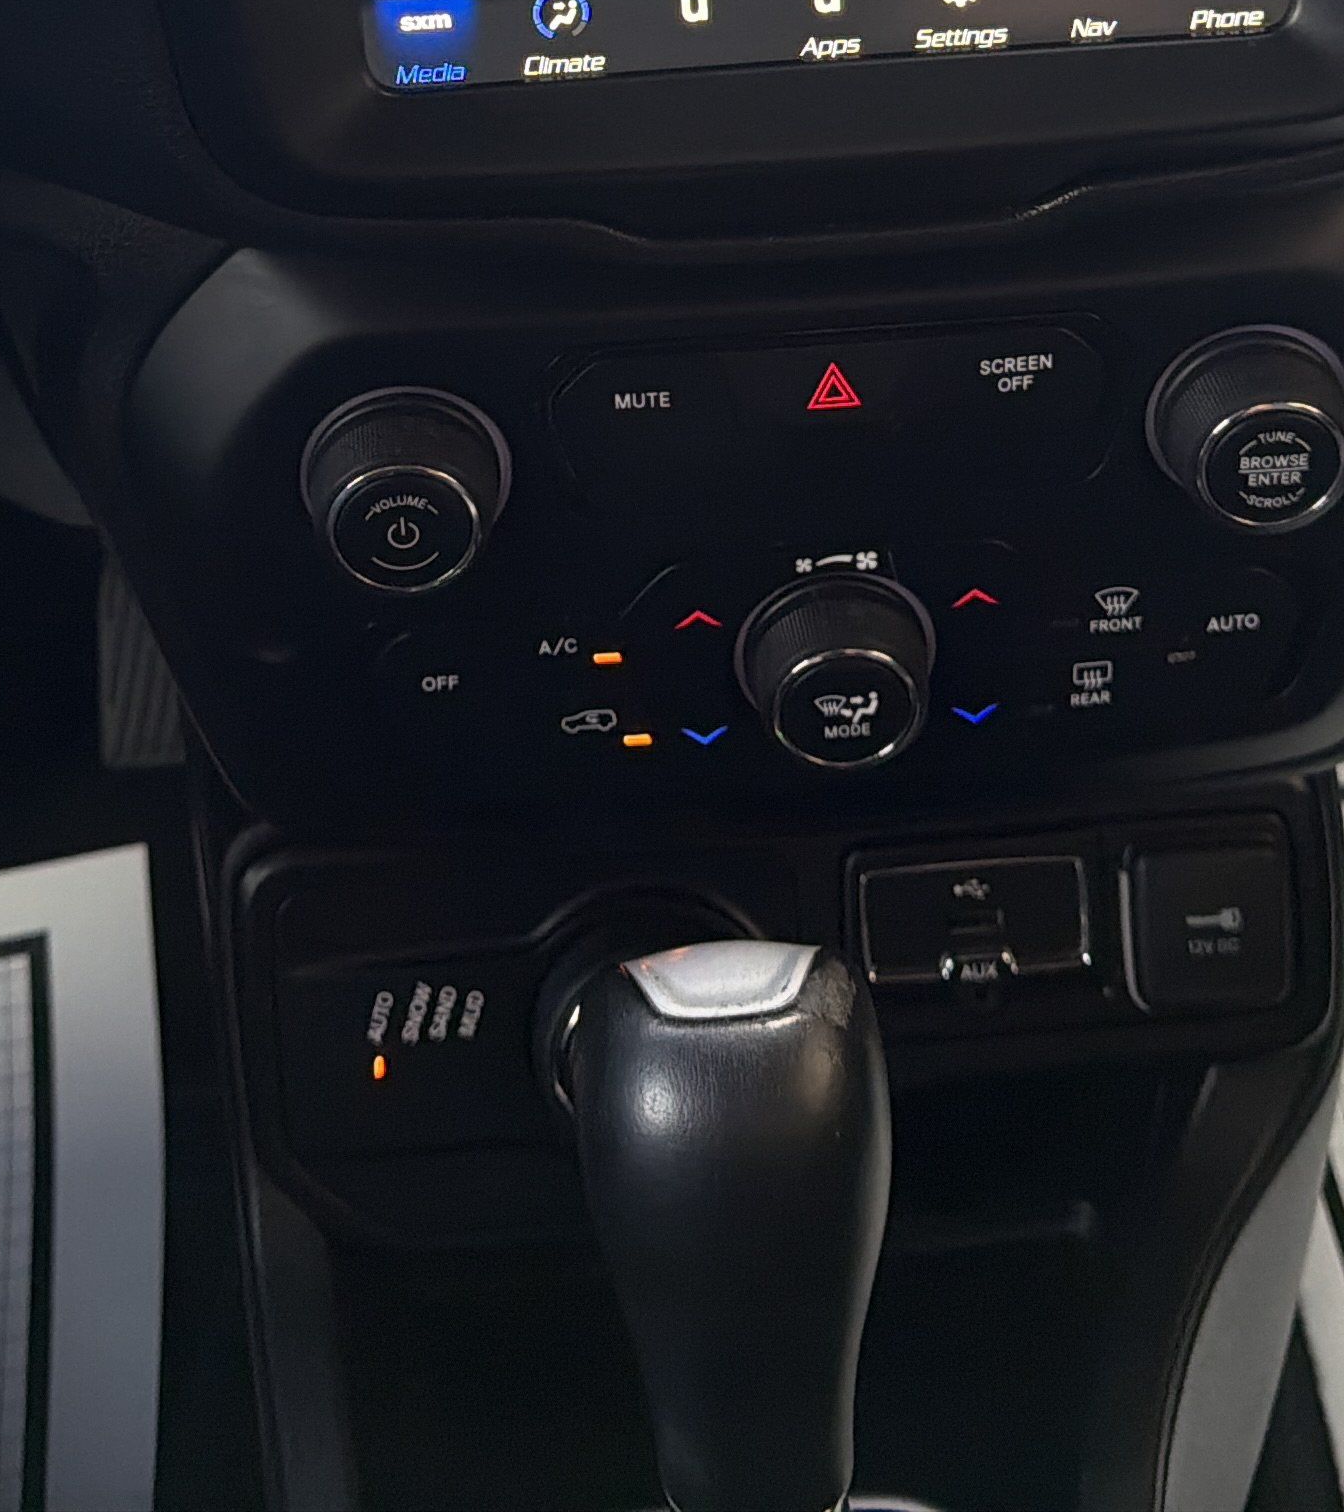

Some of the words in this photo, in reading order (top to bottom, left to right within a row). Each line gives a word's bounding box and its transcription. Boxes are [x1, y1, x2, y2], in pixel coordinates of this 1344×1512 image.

[1071, 17, 1117, 39] Nav
[1189, 8, 1265, 32] Phone
[915, 25, 1008, 50] Settings
[799, 36, 862, 59] Apps
[523, 52, 606, 77] Climate
[396, 63, 467, 87] Media
[979, 353, 1053, 375] SCREEN
[997, 374, 1034, 393] OFF
[614, 391, 672, 410] MUTE
[1257, 430, 1297, 445] TUNE
[1239, 452, 1310, 469] BROWSE
[1247, 471, 1302, 487] ENTER
[369, 495, 429, 515] VOLUME
[1246, 492, 1300, 508] SCROLL
[1089, 615, 1143, 634] FRONT
[1207, 612, 1260, 634] AUTO
[539, 637, 579, 656] A/C
[421, 675, 460, 693] OFF
[1069, 690, 1111, 707] REAR
[824, 722, 871, 740] MODE
[960, 961, 999, 983] AUX
